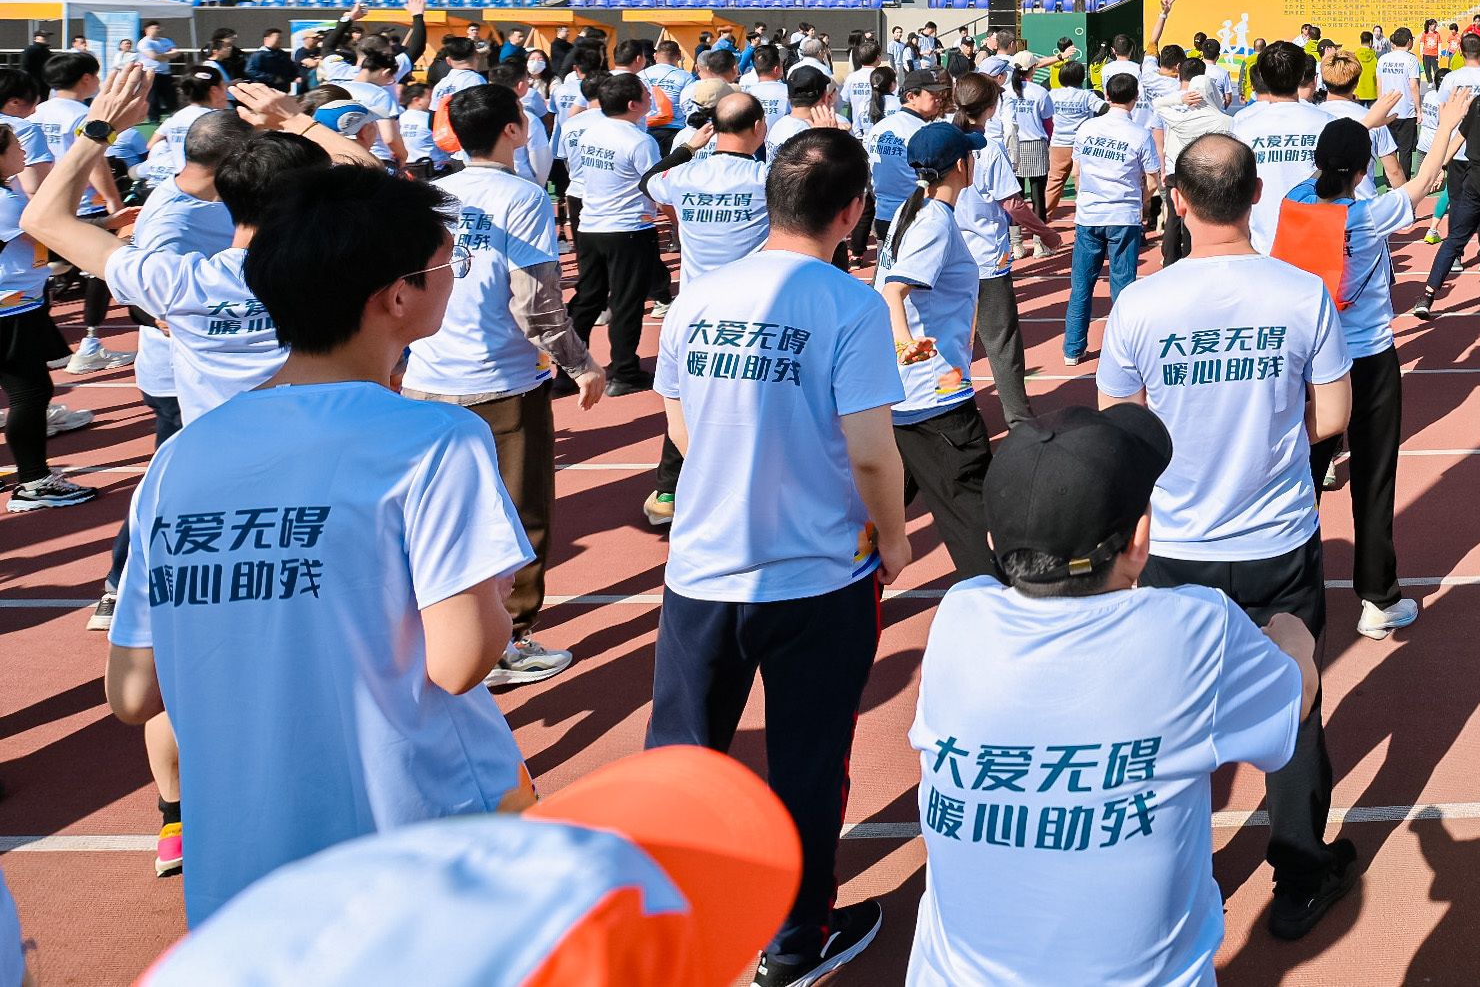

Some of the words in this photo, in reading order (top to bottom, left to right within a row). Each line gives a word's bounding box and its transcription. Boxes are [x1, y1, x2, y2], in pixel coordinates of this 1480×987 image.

[580, 144, 616, 161] 大爱无碍
[1081, 145, 1127, 163] 暖心助残
[1083, 135, 1129, 151] 大爱无碍
[1251, 134, 1318, 149] 大爱无碍
[1254, 149, 1317, 164] 暖心助残
[681, 192, 753, 207] 大爱无碍
[681, 208, 753, 223] 暖心助残
[688, 319, 812, 355] 大爱无碍
[1159, 326, 1287, 359] 大爱无碍
[686, 350, 802, 384] 暖心助残
[1161, 355, 1285, 387] 暖心助残
[150, 506, 331, 556] 大爱无碍
[149, 557, 323, 608] 暖心助残
[932, 735, 1162, 792] 大爱无碍
[926, 784, 1158, 851] 暖心助残
